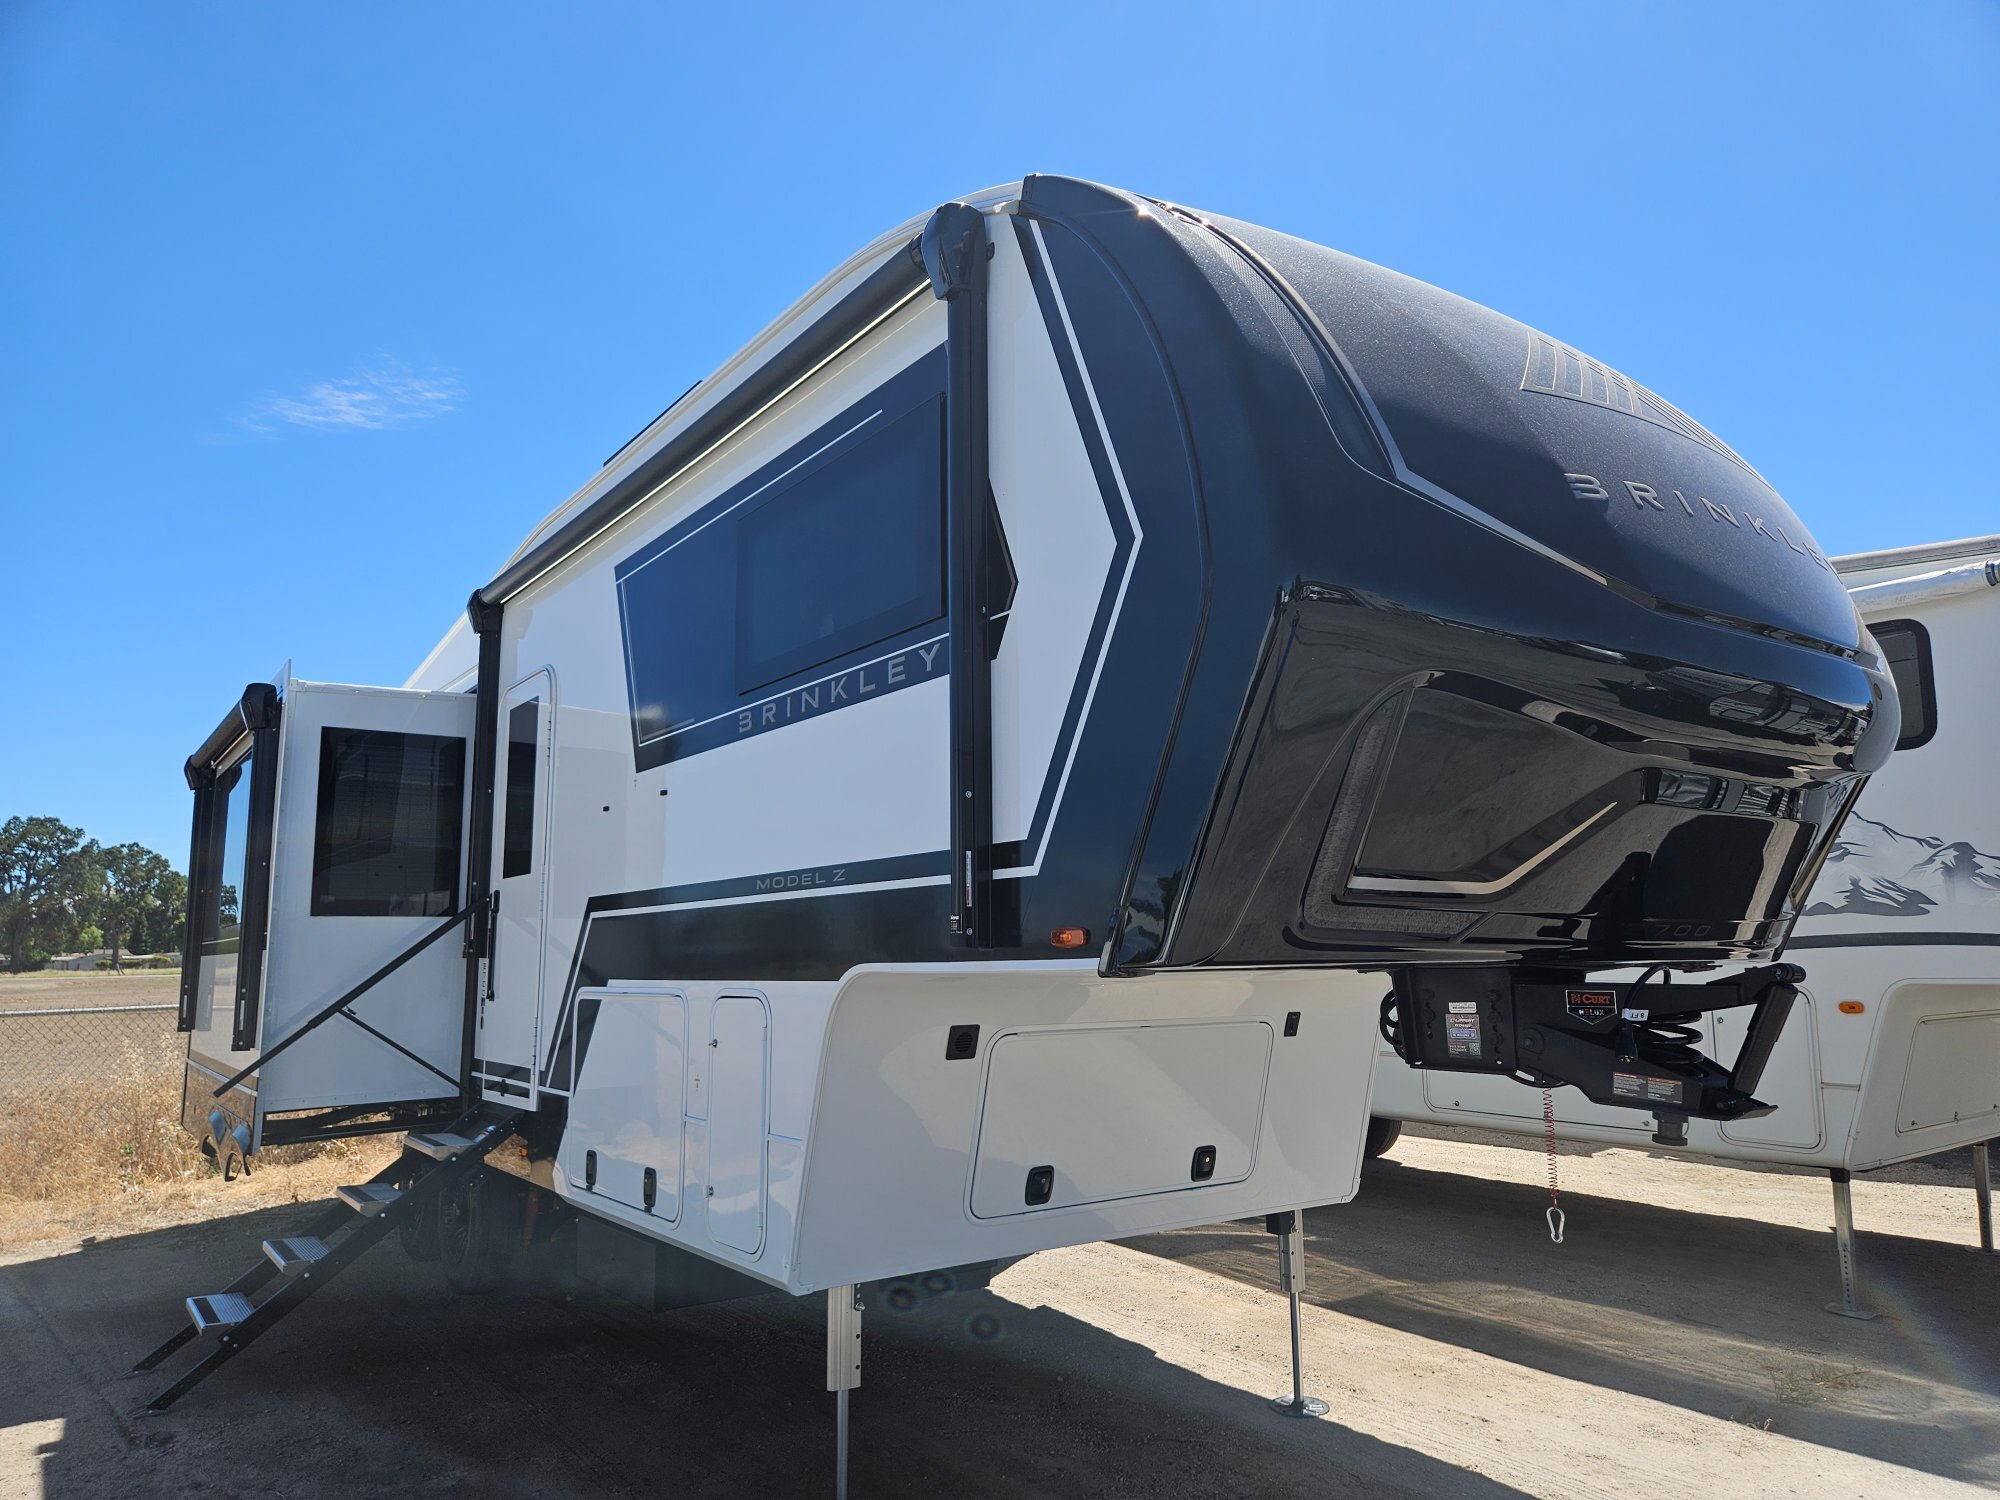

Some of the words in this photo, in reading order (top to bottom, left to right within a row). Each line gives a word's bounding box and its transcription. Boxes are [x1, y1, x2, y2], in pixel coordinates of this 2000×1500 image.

[739, 643, 941, 733] BRINKLEY
[756, 872, 826, 890] MODEL
[832, 868, 846, 882] Z
[1582, 994, 1611, 1004] CURT
